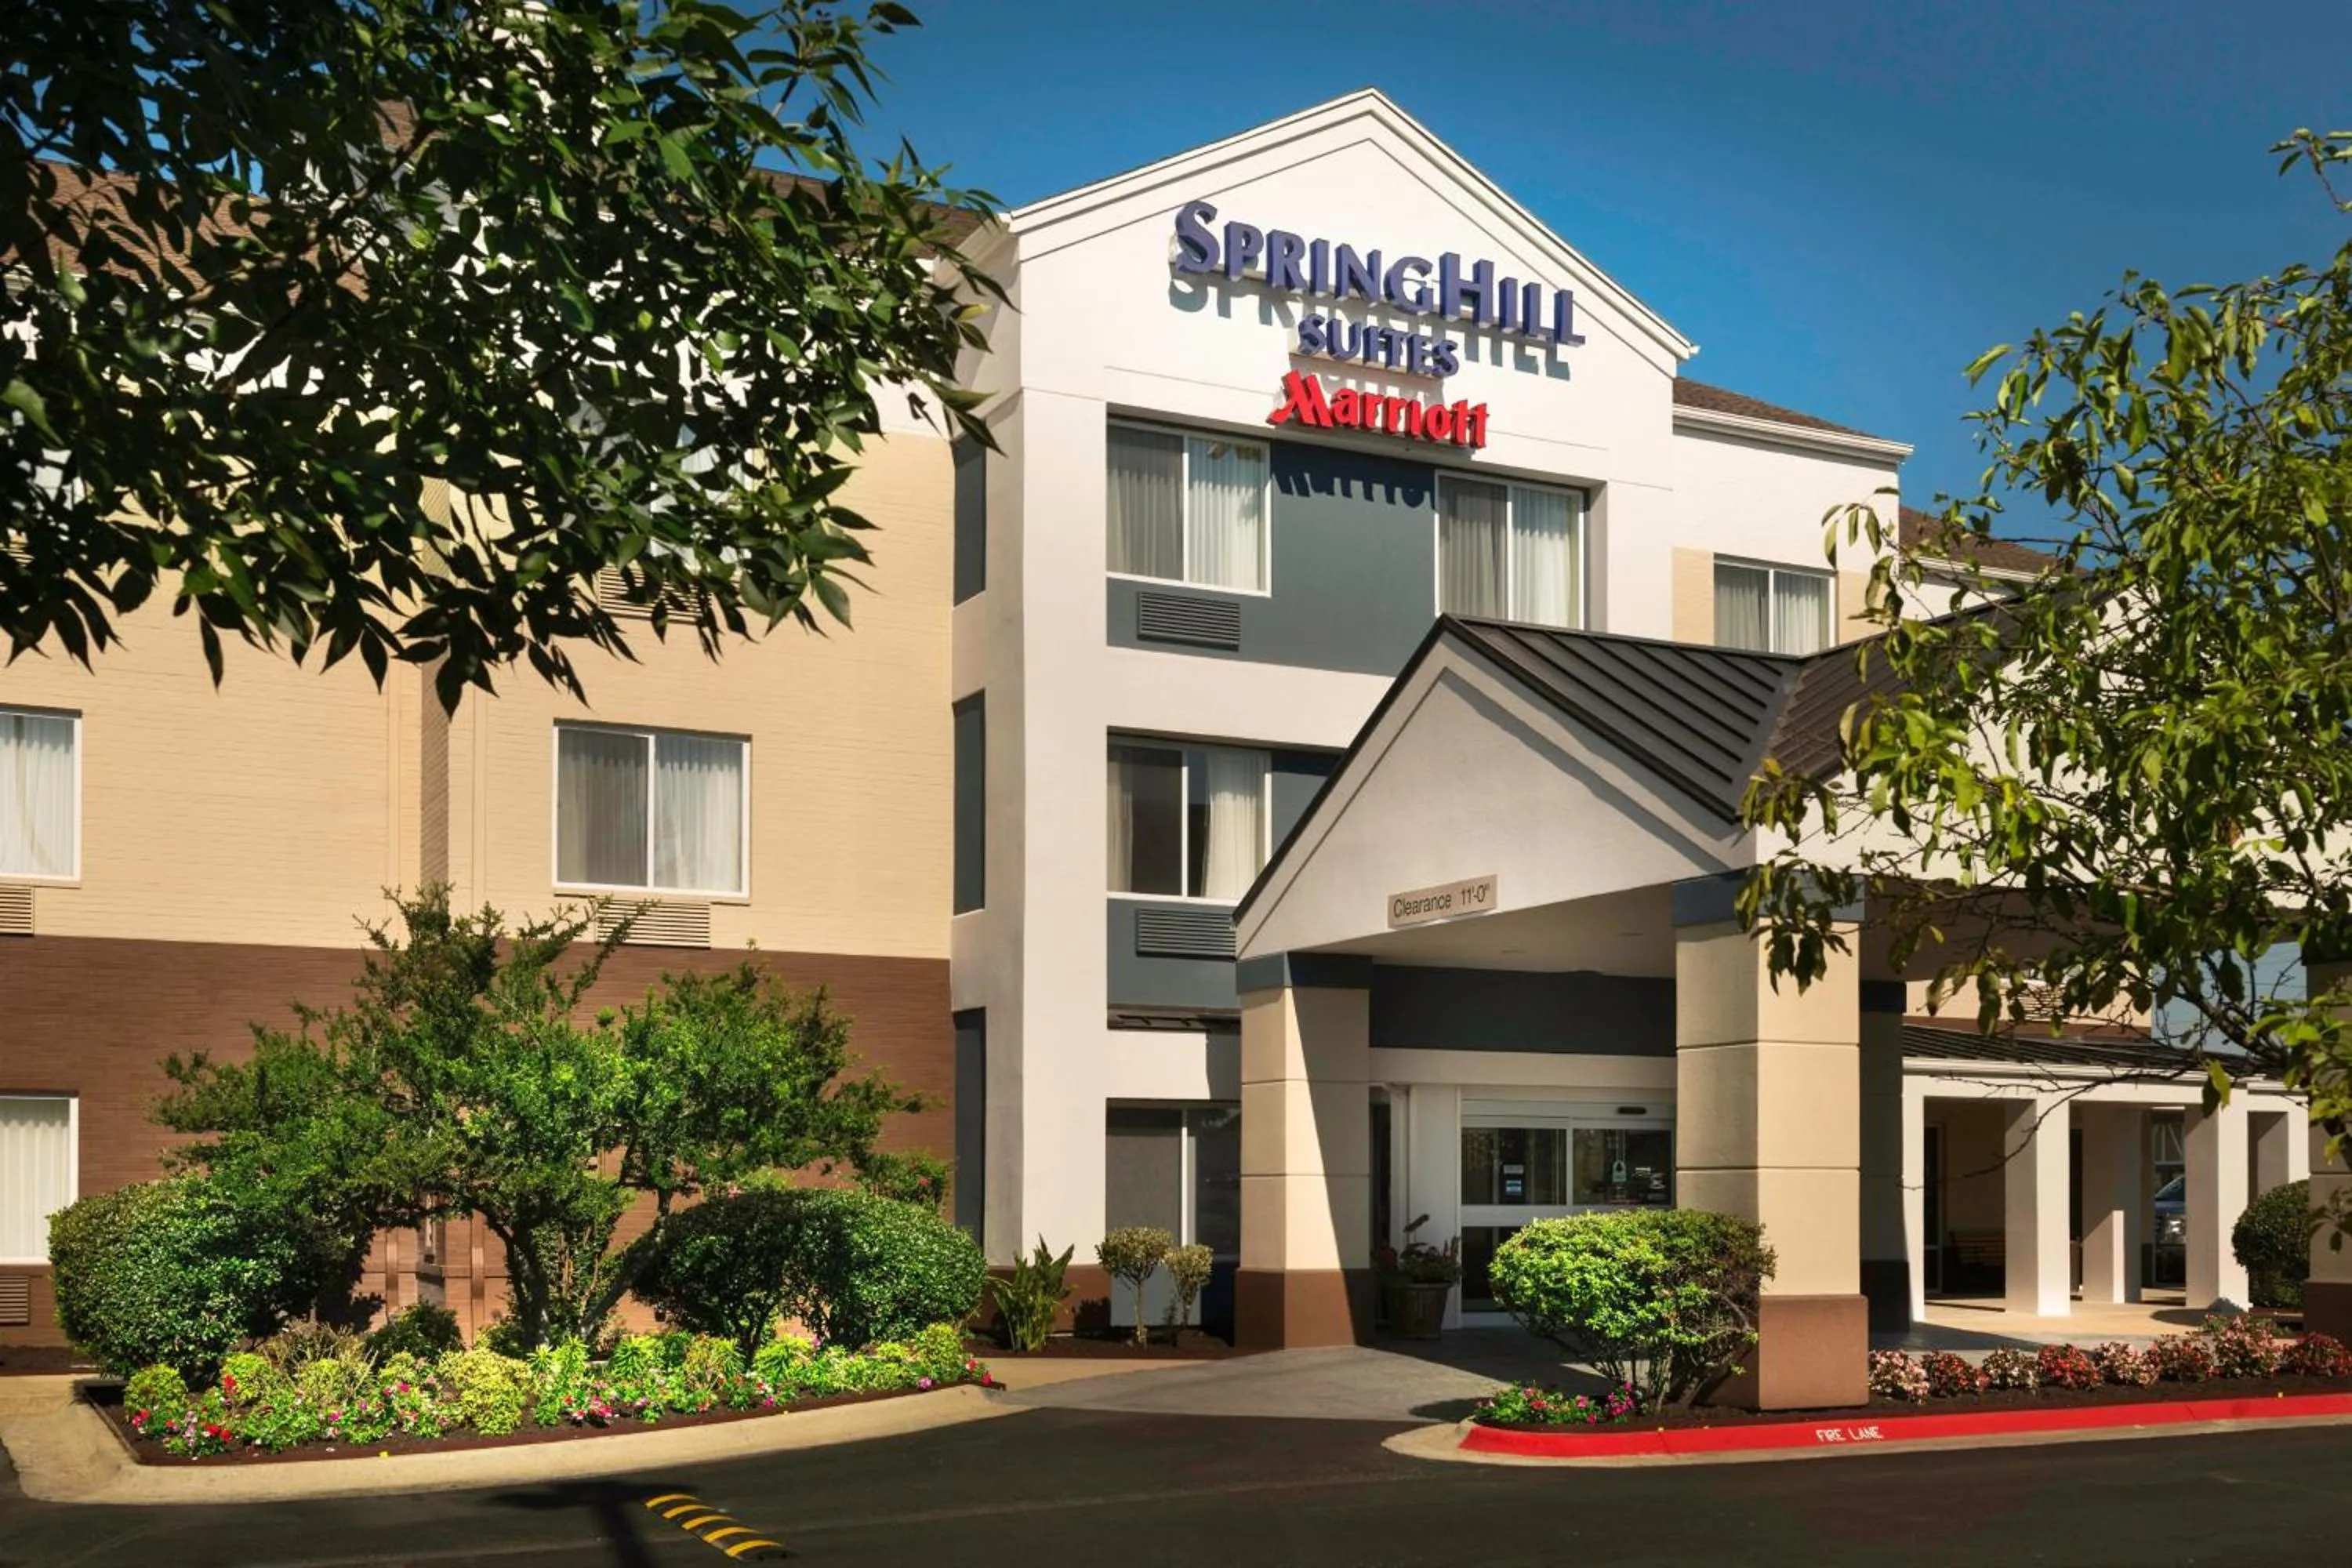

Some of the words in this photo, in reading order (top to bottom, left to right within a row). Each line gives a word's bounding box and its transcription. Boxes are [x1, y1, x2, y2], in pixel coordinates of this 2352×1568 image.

[1174, 199, 1586, 346] SPRINGHILL
[1298, 314, 1460, 378] SUITES
[1266, 368, 1490, 449] Marriott
[1393, 893, 1452, 918] Clearance
[1815, 1428, 1846, 1442] FIRE
[1848, 1426, 1885, 1441] LANE
